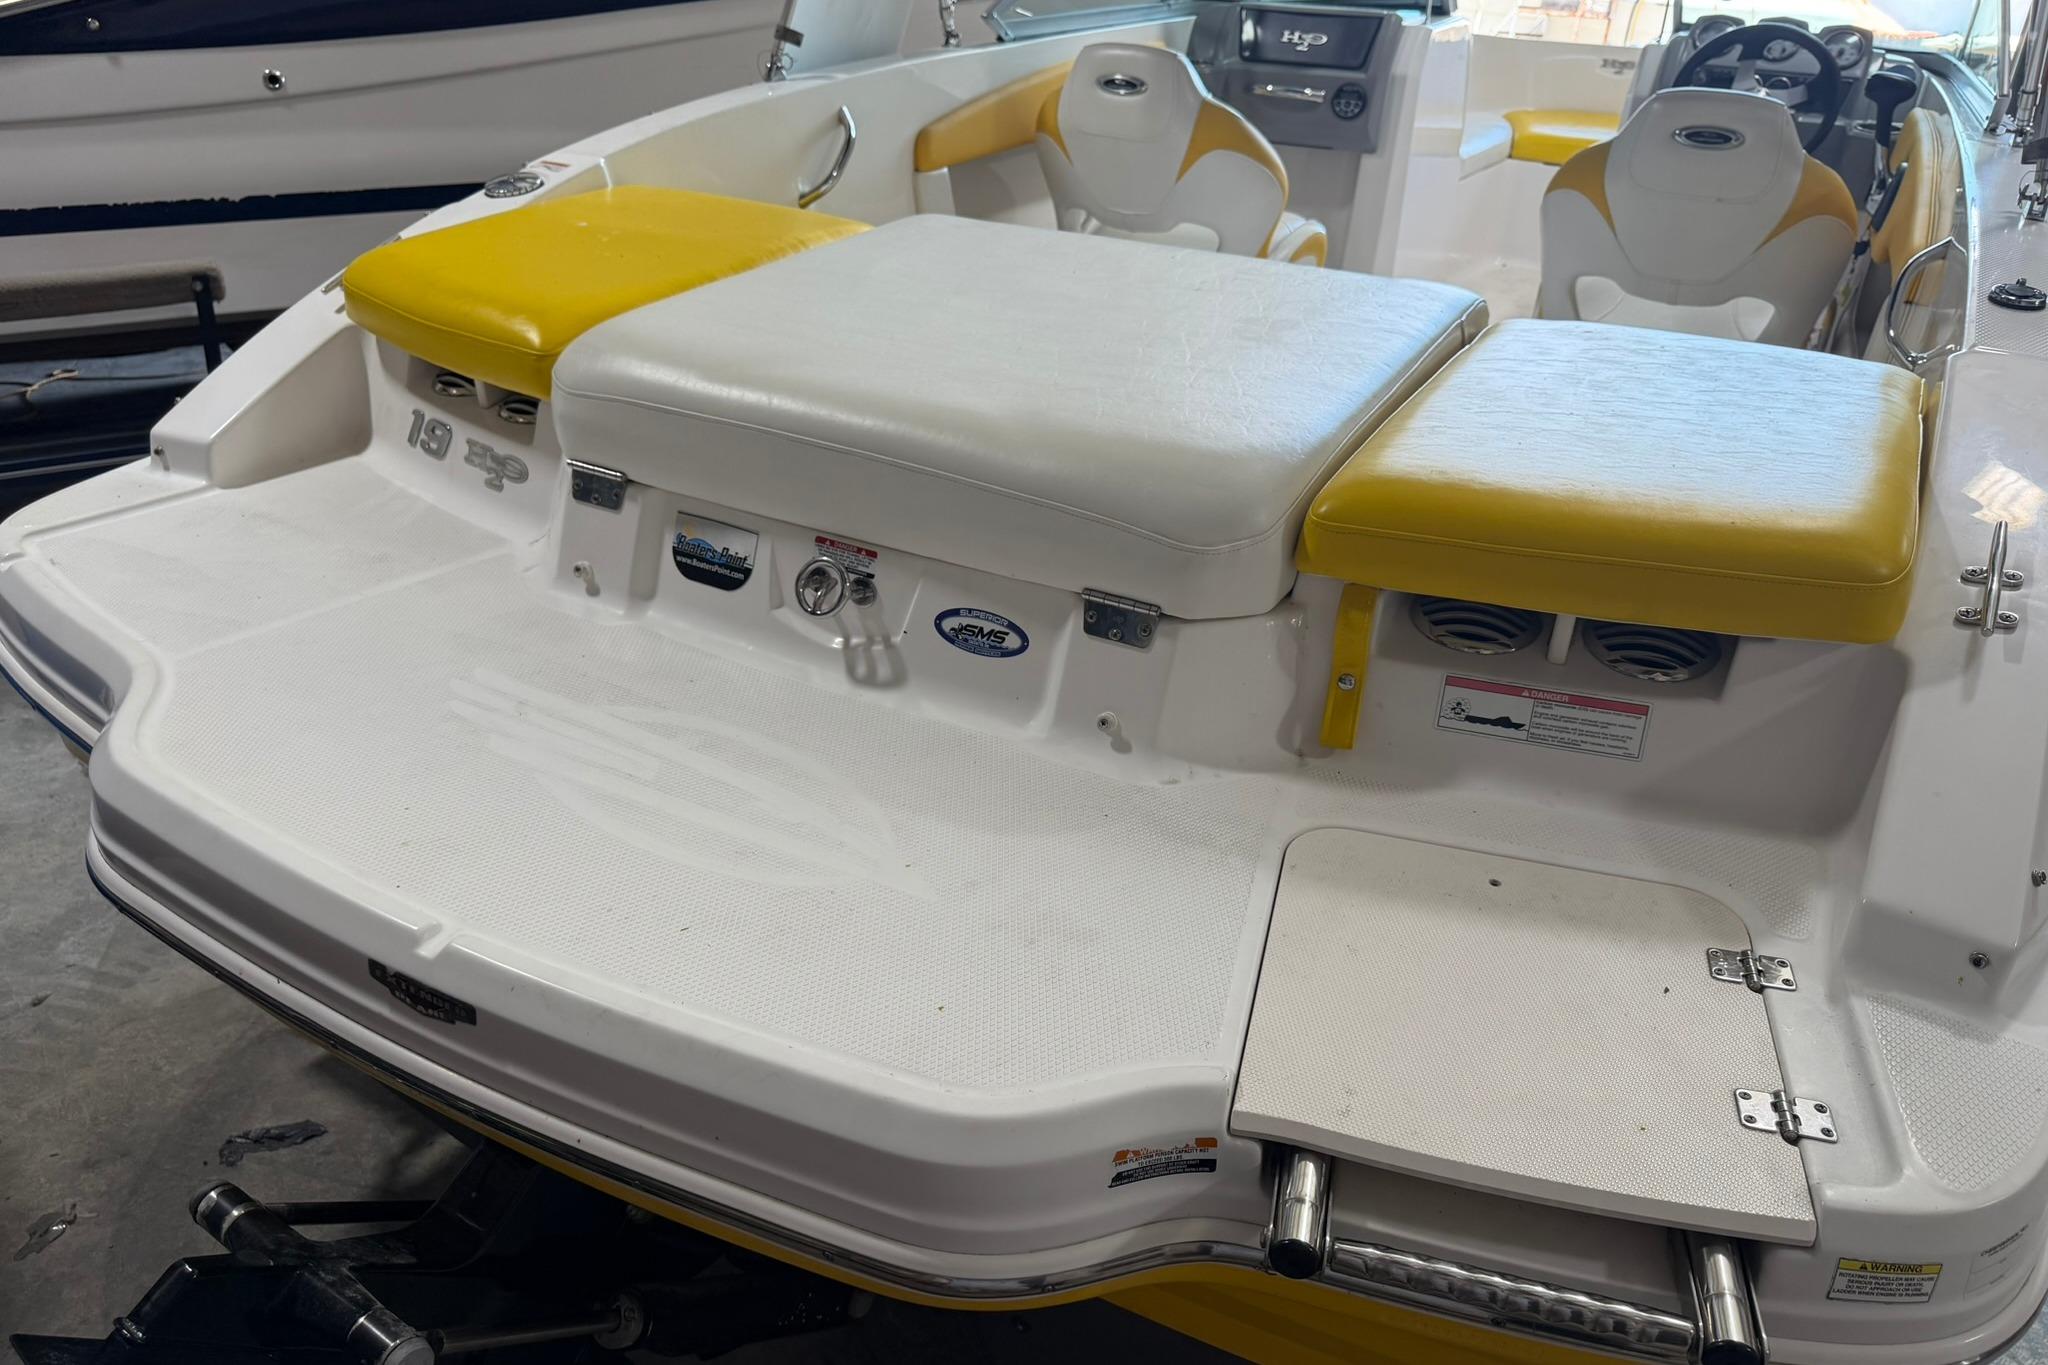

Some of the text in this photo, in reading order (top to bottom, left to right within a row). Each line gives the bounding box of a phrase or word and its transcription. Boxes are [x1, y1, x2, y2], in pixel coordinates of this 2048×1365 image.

[407, 408, 453, 462] 19
[833, 542, 858, 552] DANGER
[719, 546, 749, 568] Point
[960, 609, 1009, 627] SUPERIOR
[962, 623, 1010, 645] SMS
[1530, 690, 1569, 702] DANGER
[1871, 1263, 1924, 1273] WARNING
